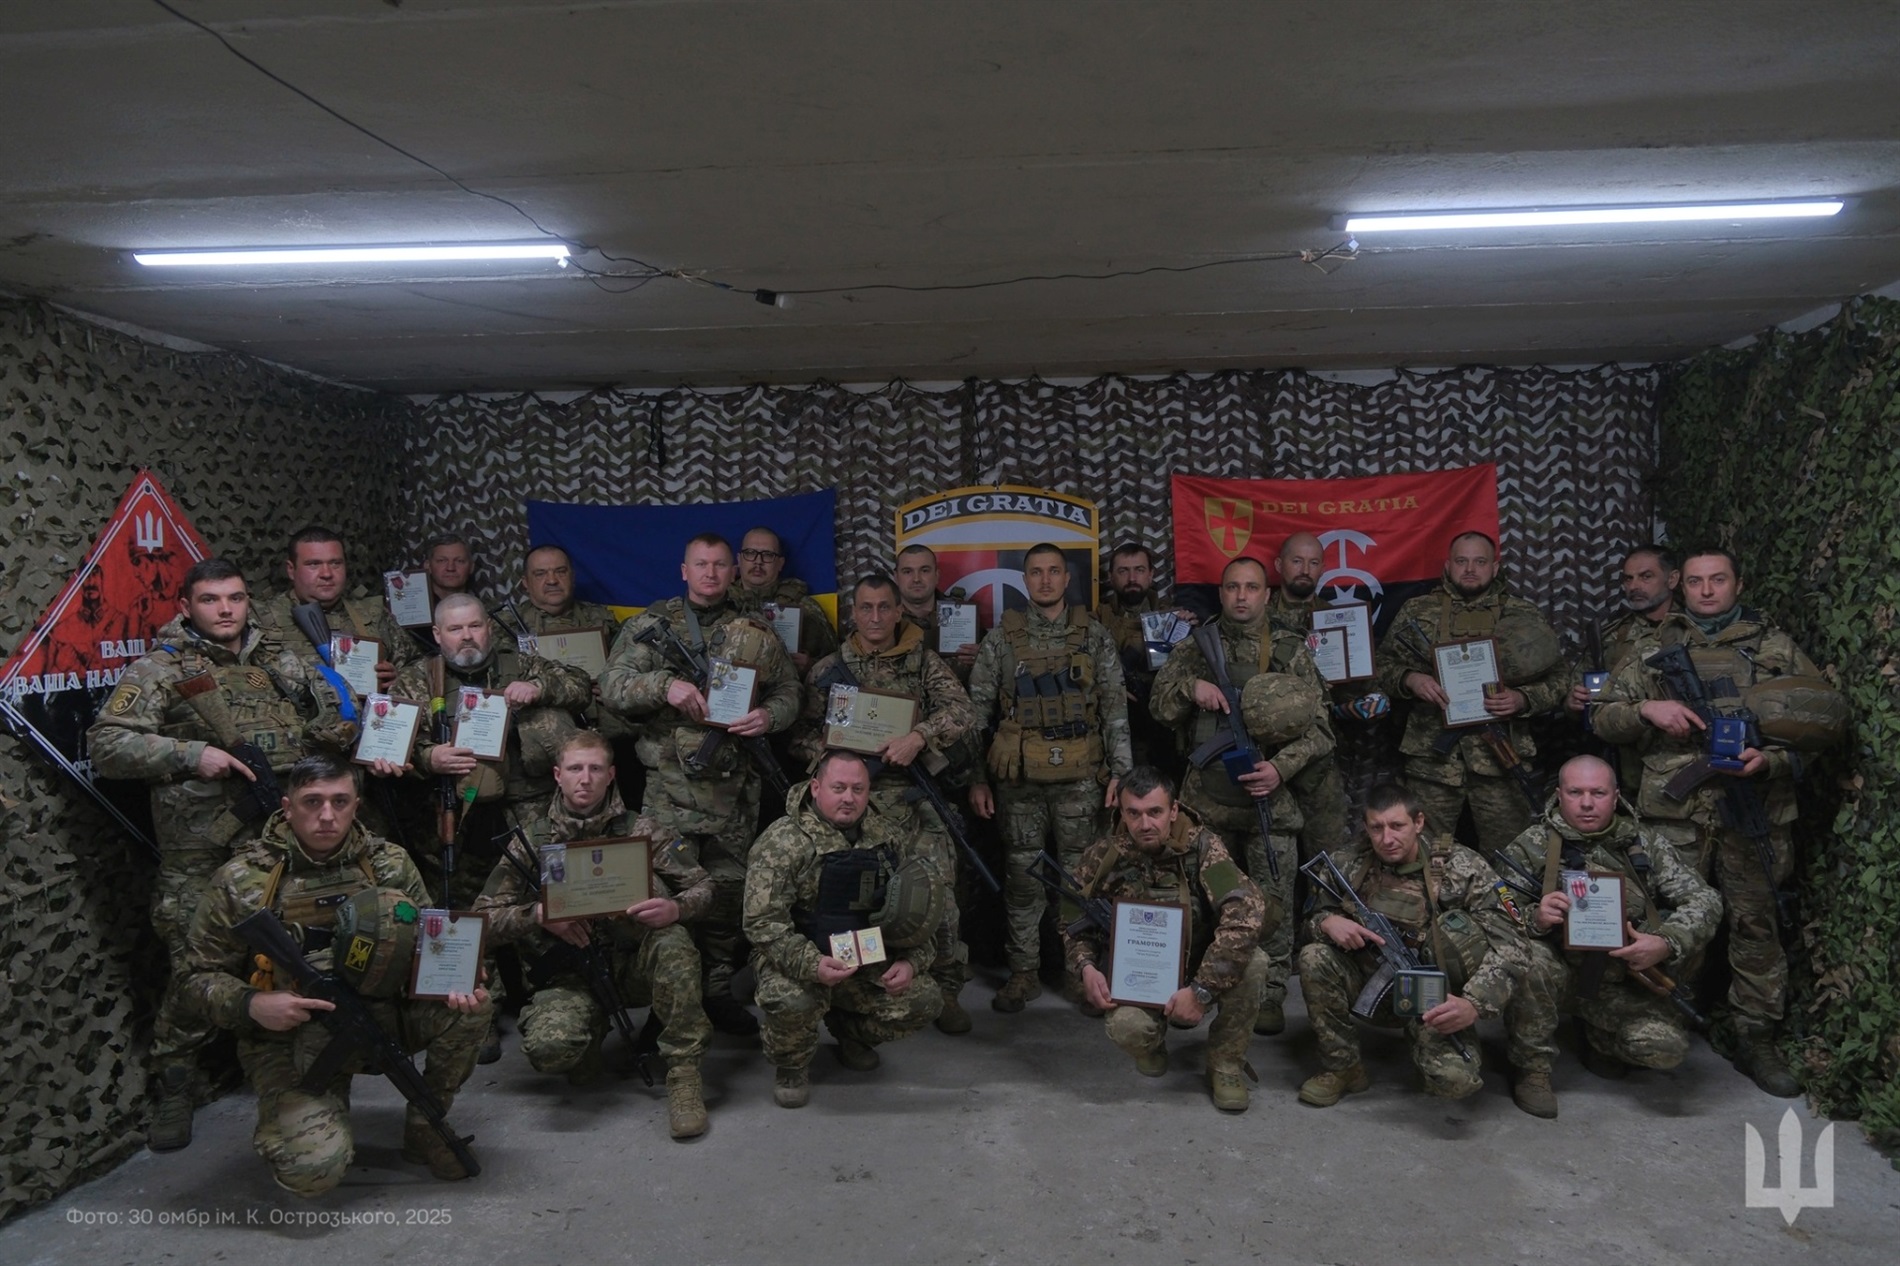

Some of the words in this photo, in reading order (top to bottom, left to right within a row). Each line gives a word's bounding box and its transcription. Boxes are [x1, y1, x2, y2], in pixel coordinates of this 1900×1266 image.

[903, 498, 962, 531] DEI
[966, 494, 1091, 527] GRATIA
[1261, 501, 1309, 514] DEI
[1317, 495, 1419, 515] GRATIA
[12, 671, 83, 696] ВАША
[1127, 938, 1167, 948] ГРАМОТОЮ
